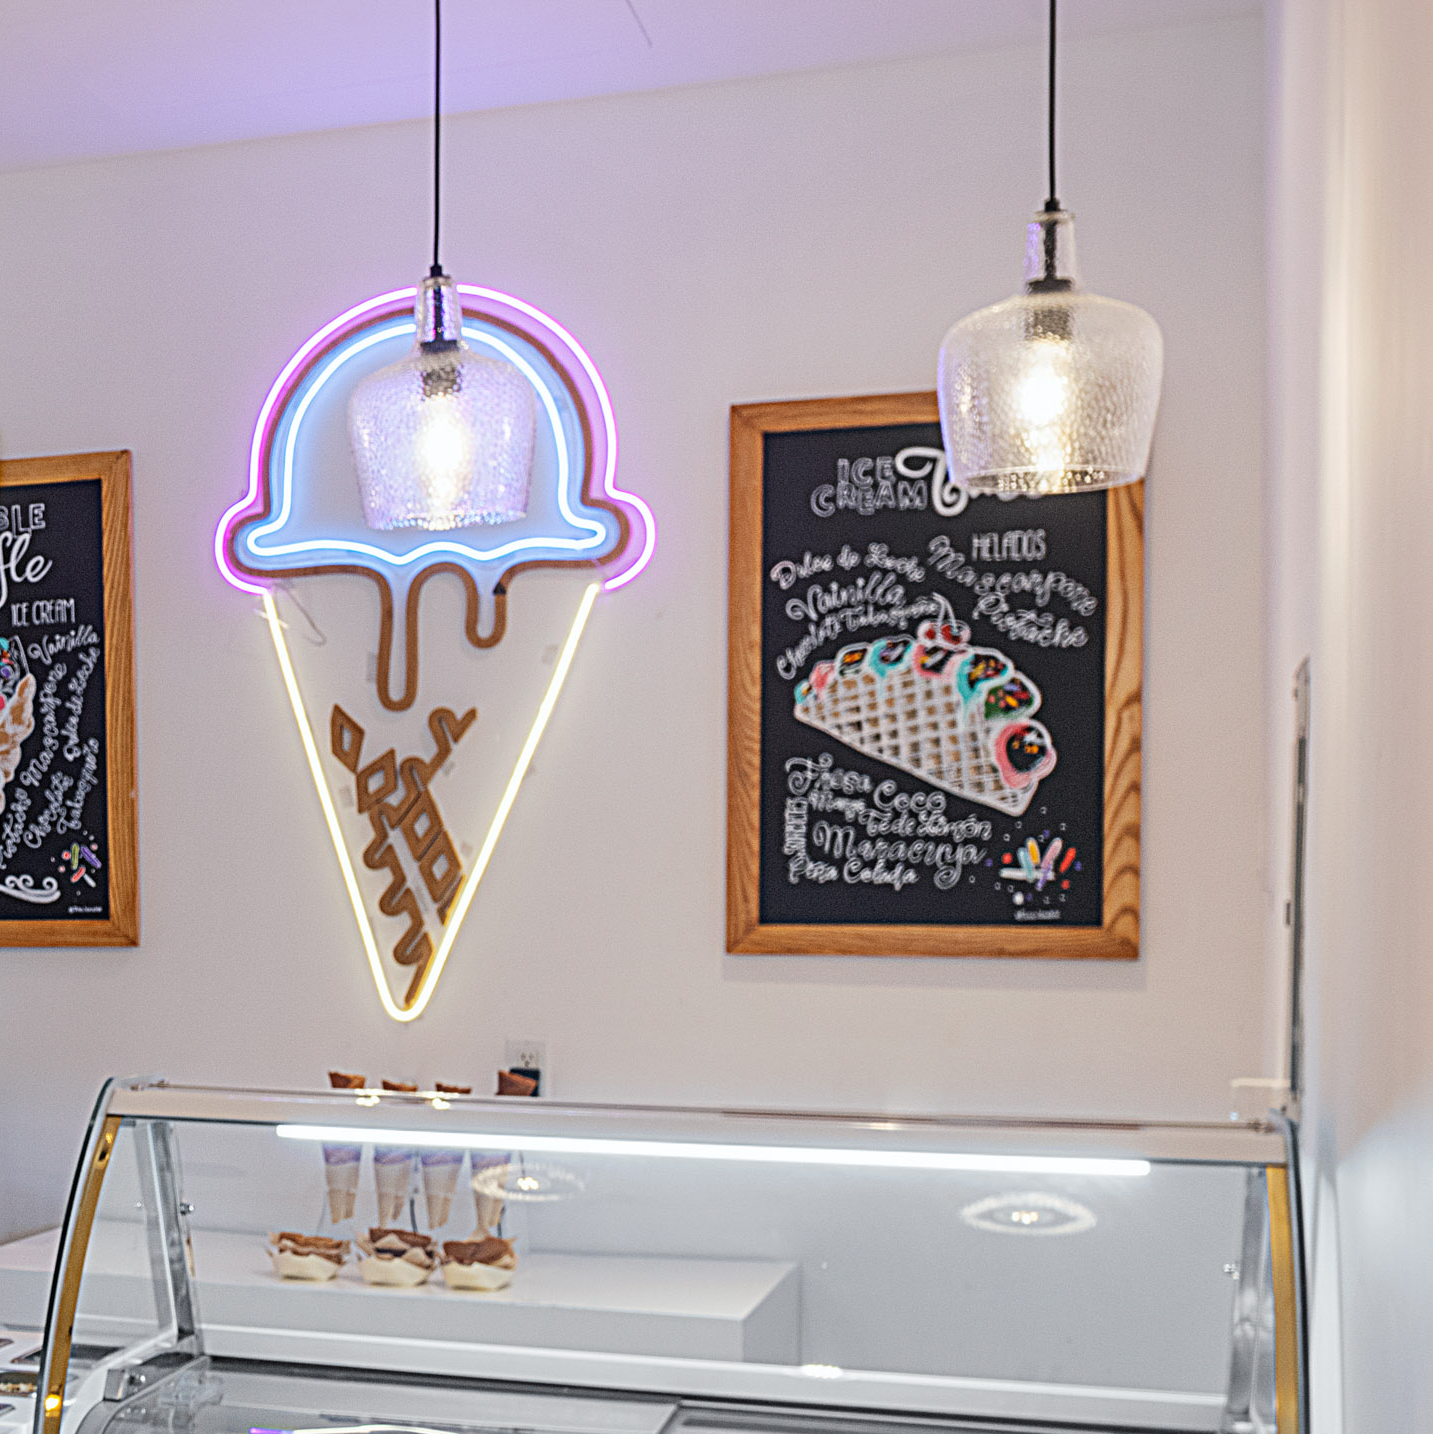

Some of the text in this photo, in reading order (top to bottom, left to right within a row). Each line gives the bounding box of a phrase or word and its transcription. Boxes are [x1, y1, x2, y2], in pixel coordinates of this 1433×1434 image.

[836, 456, 895, 486] ICE
[810, 480, 928, 518] CREAM
[863, 542, 926, 583] Leche
[971, 528, 1047, 562] HELADOS
[785, 570, 905, 621] Vainilla
[927, 534, 1099, 617] Mascarpone
[10, 598, 76, 627] ICE CREAM
[972, 591, 1089, 648] Pistacho
[27, 624, 100, 665] Vainilla
[19, 662, 67, 787] Mascarpone
[785, 752, 872, 796] Fresa
[23, 771, 74, 848] Chocolate
[873, 779, 947, 812] Coco
